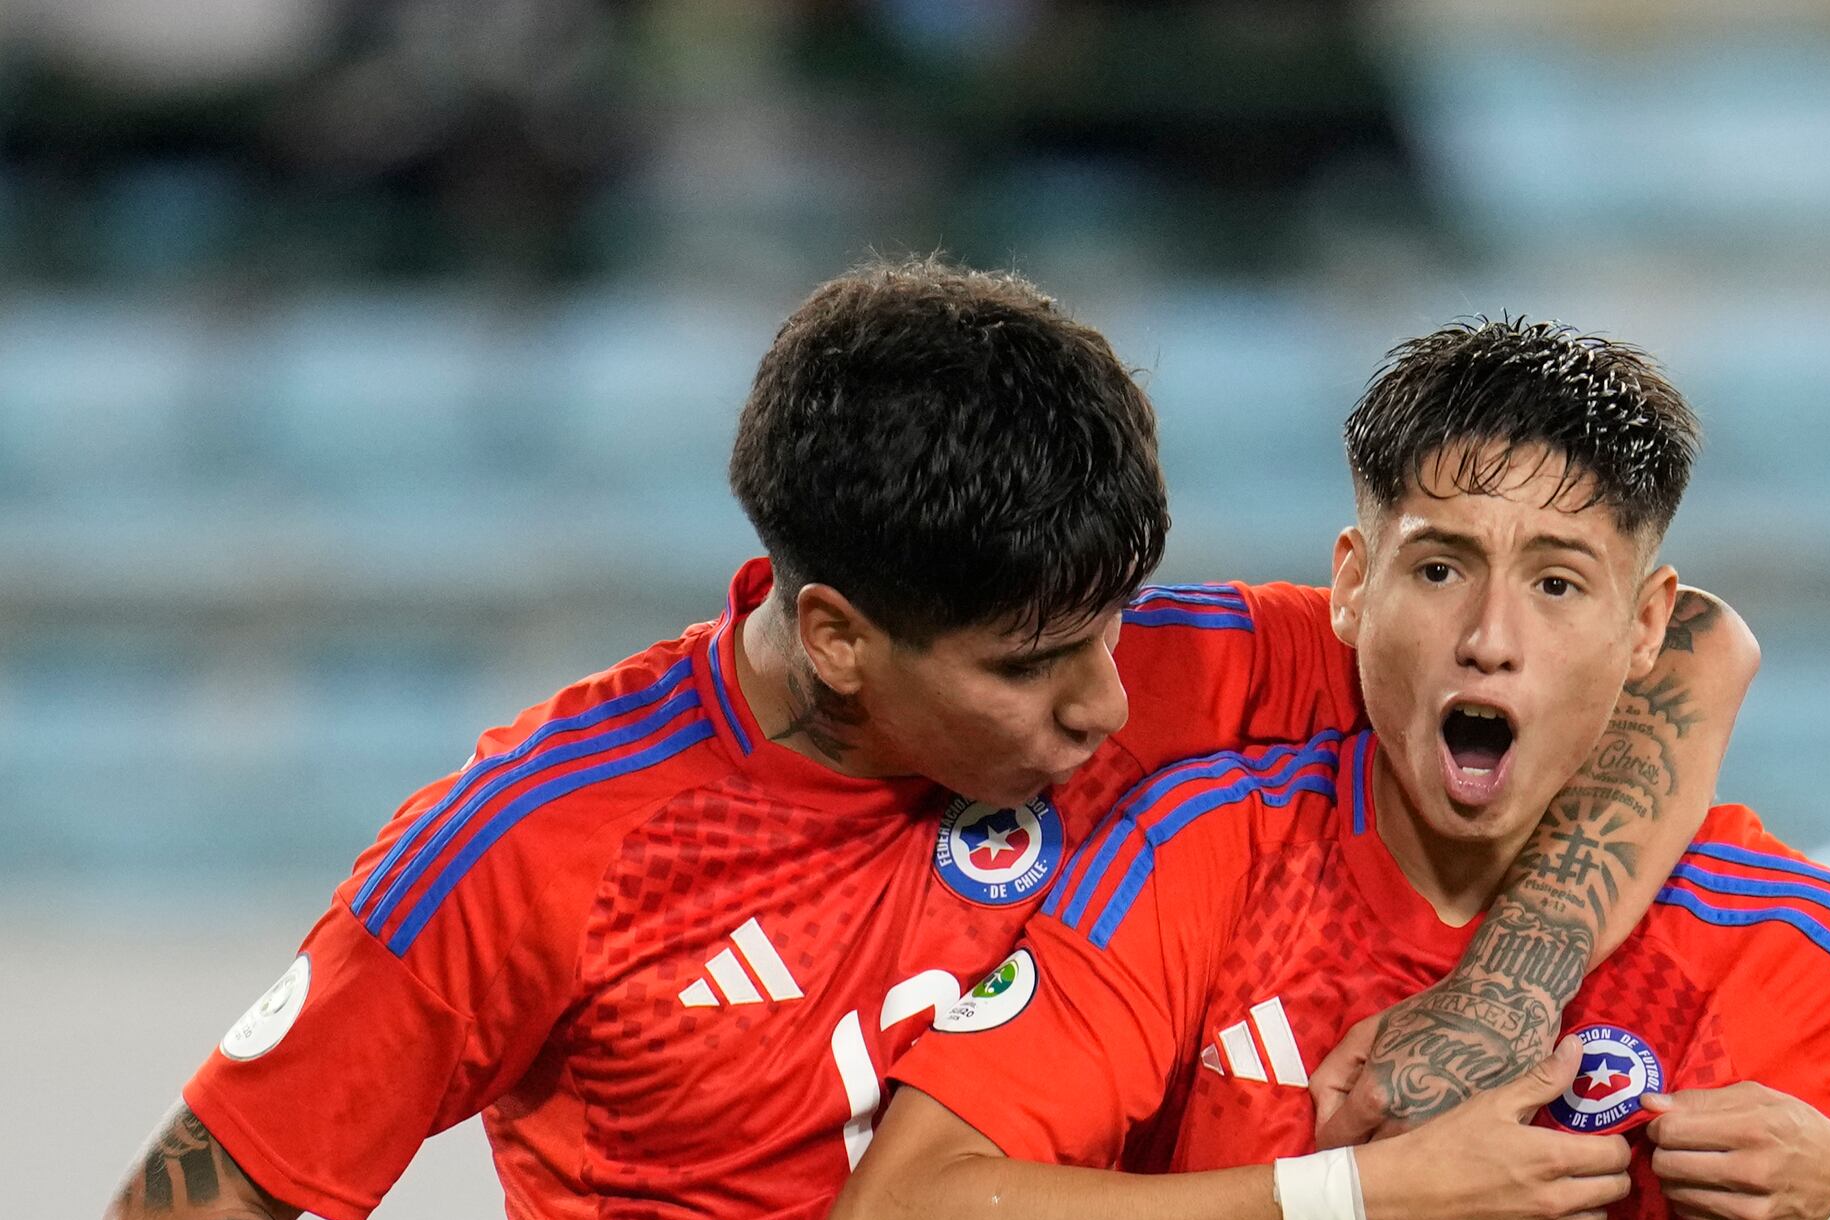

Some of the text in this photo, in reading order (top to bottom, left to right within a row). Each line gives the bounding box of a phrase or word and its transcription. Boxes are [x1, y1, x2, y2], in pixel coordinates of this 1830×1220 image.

[936, 797, 973, 868] FEDERACIO
[989, 862, 1049, 900] DE CHILE
[1620, 1033, 1640, 1049] DE
[1638, 1049, 1661, 1092] FUTBOL
[1571, 1102, 1630, 1128] DE CHILE
